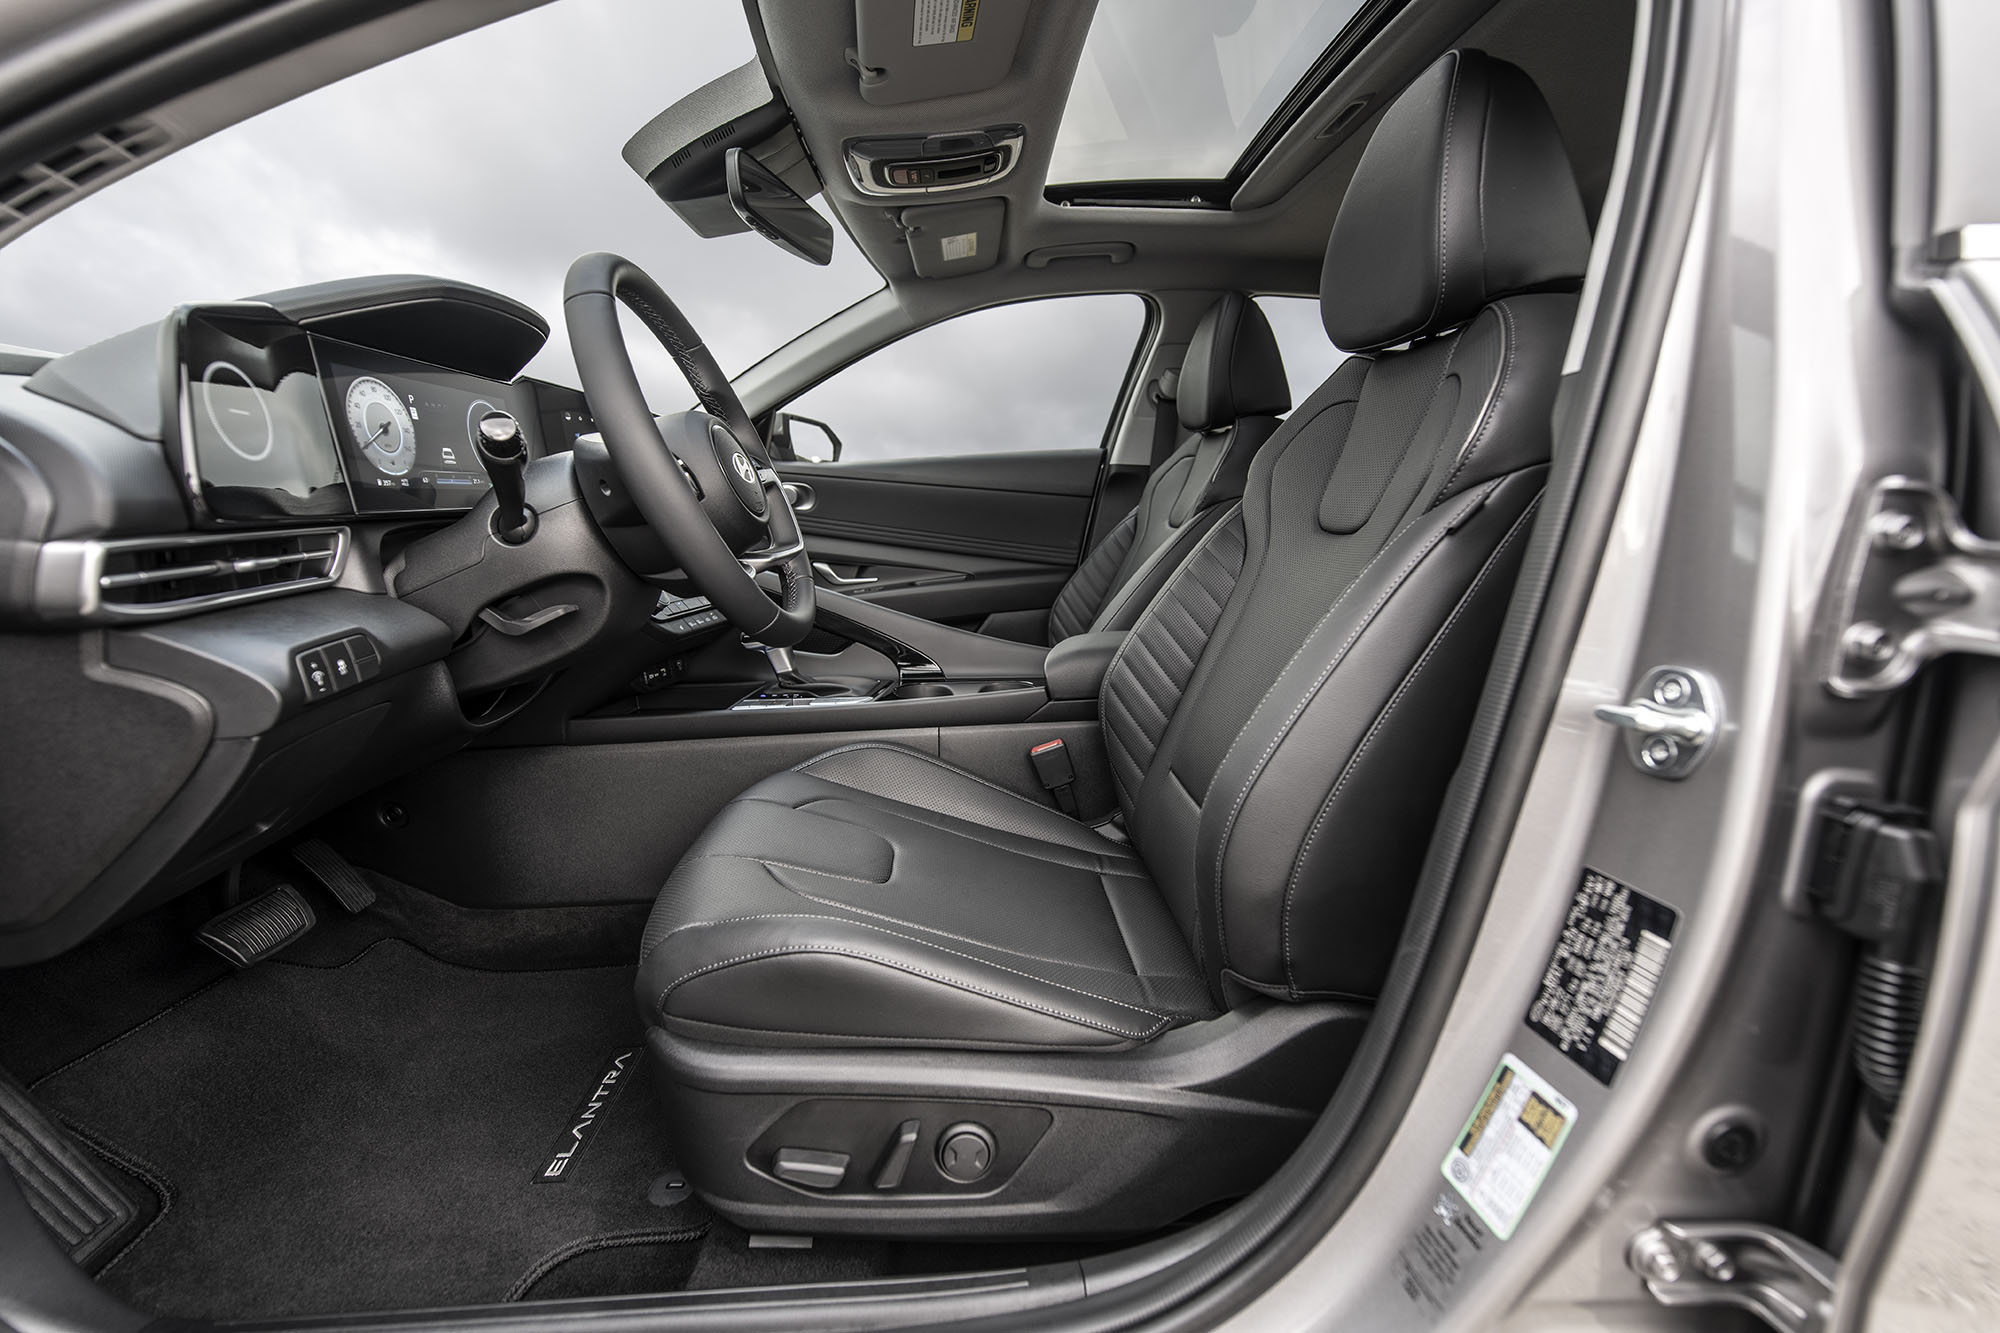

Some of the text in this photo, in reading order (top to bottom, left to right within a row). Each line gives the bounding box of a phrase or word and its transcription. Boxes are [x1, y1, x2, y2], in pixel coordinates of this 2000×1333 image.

[961, 0, 977, 28] ARNING
[408, 394, 415, 404] P
[544, 1052, 632, 1177] ELANTRA
